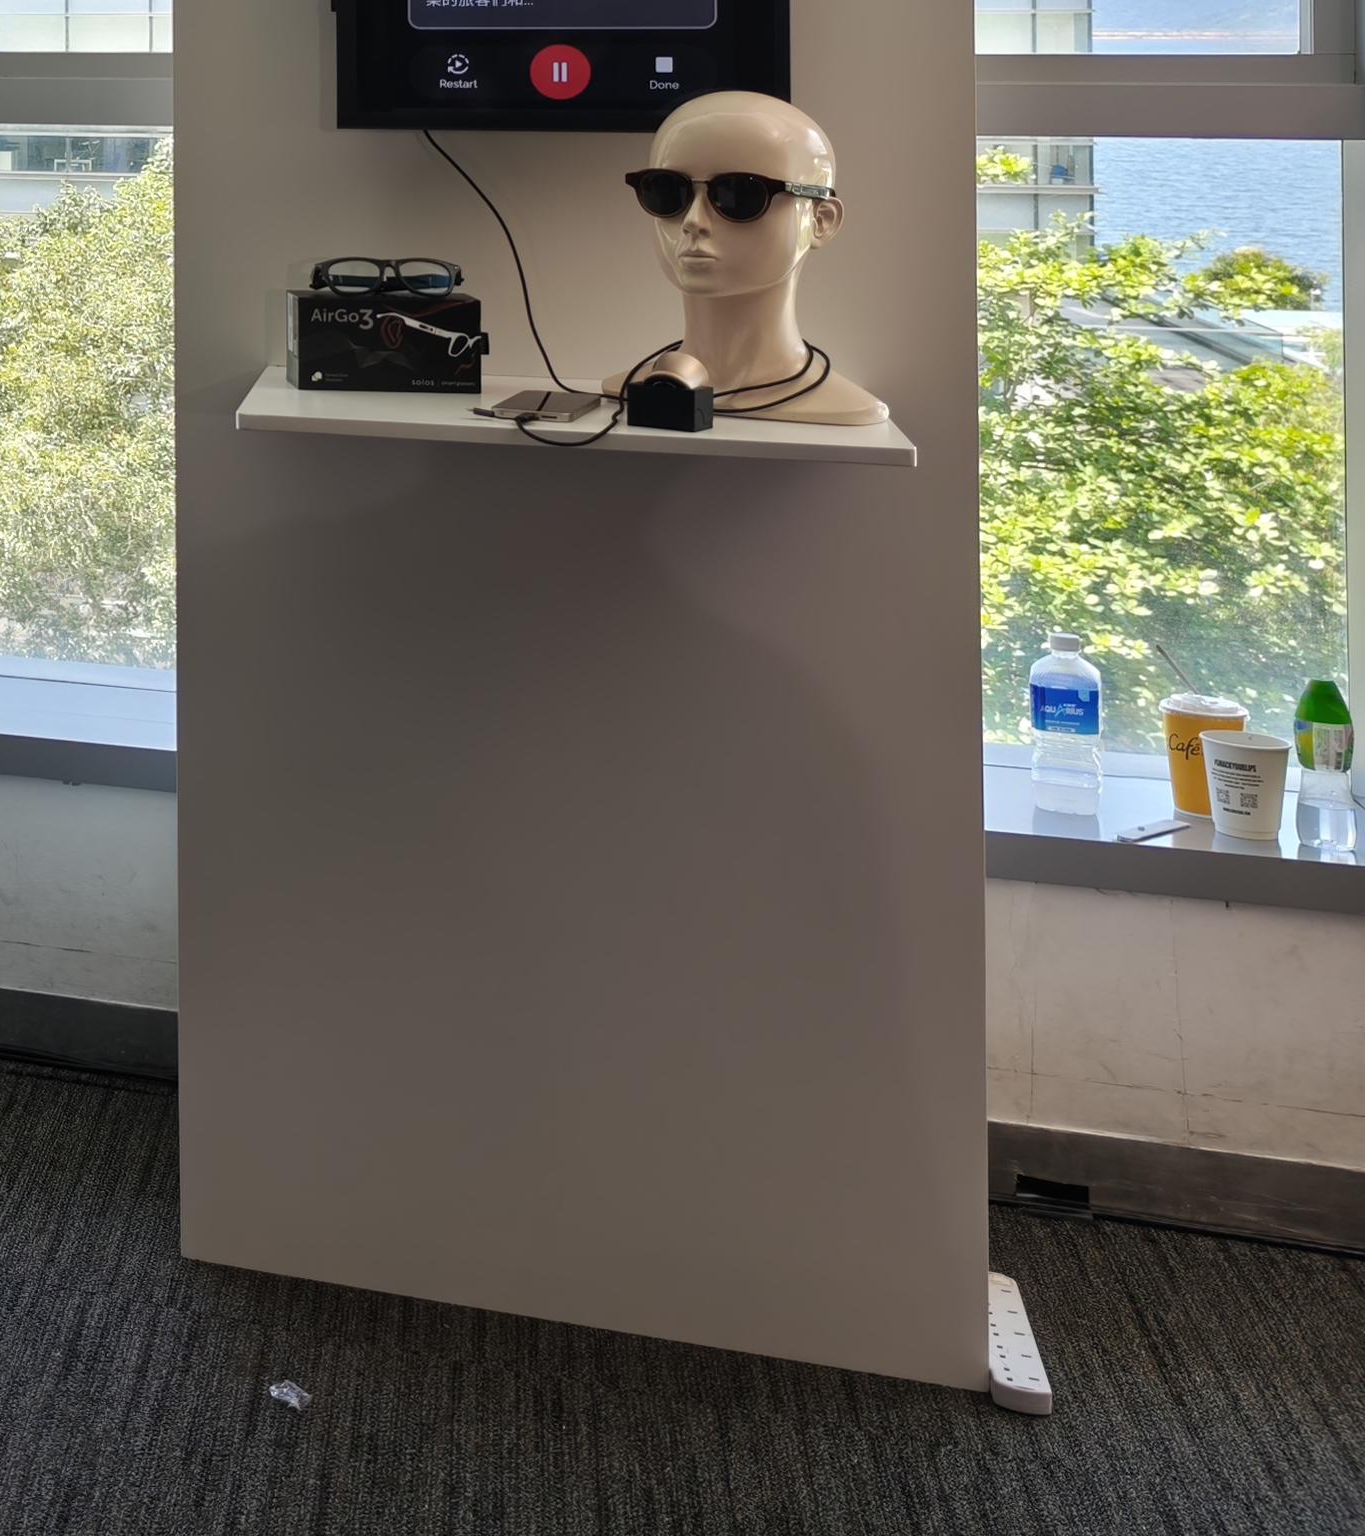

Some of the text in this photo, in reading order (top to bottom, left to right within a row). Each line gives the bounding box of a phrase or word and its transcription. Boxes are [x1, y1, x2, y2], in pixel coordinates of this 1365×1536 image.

[439, 79, 679, 90] Restart Done
[412, 378, 434, 387] solos
